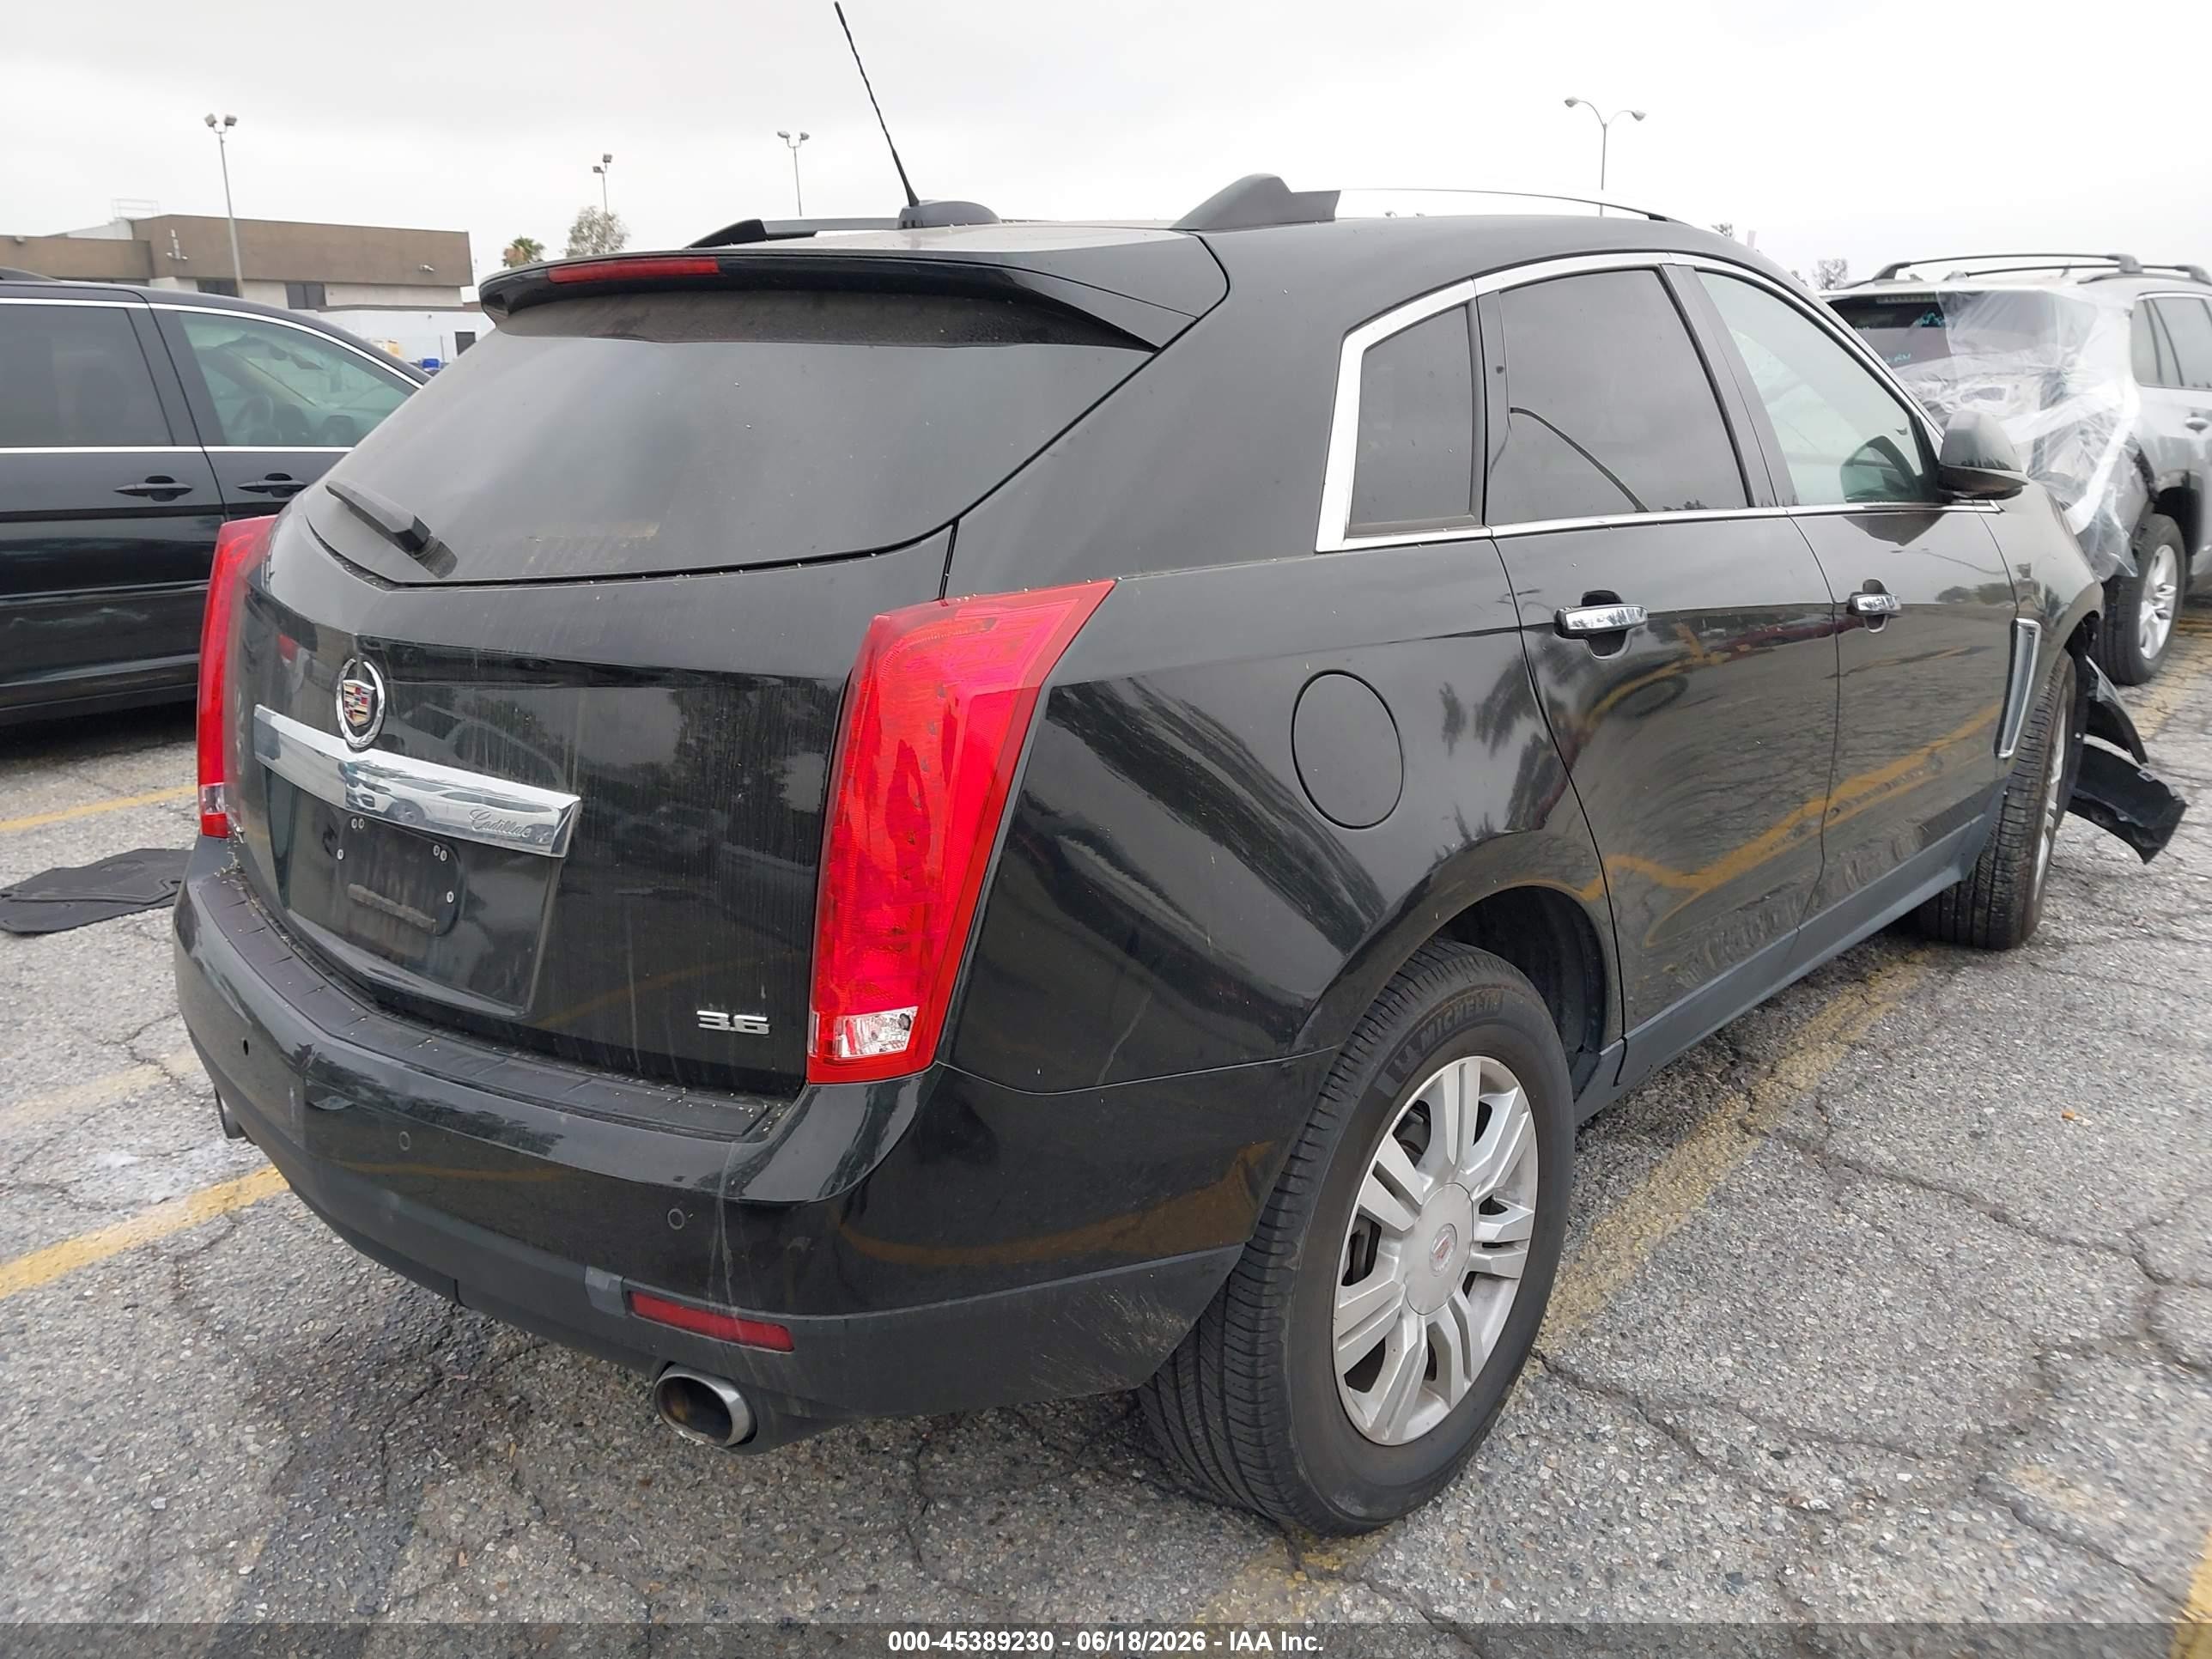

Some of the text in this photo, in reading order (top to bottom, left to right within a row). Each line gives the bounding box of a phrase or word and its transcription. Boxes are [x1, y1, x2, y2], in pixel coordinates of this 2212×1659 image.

[469, 809, 532, 838] Cadillac
[696, 1010, 769, 1035] 3.6
[1420, 993, 1499, 1047] MICHELIN
